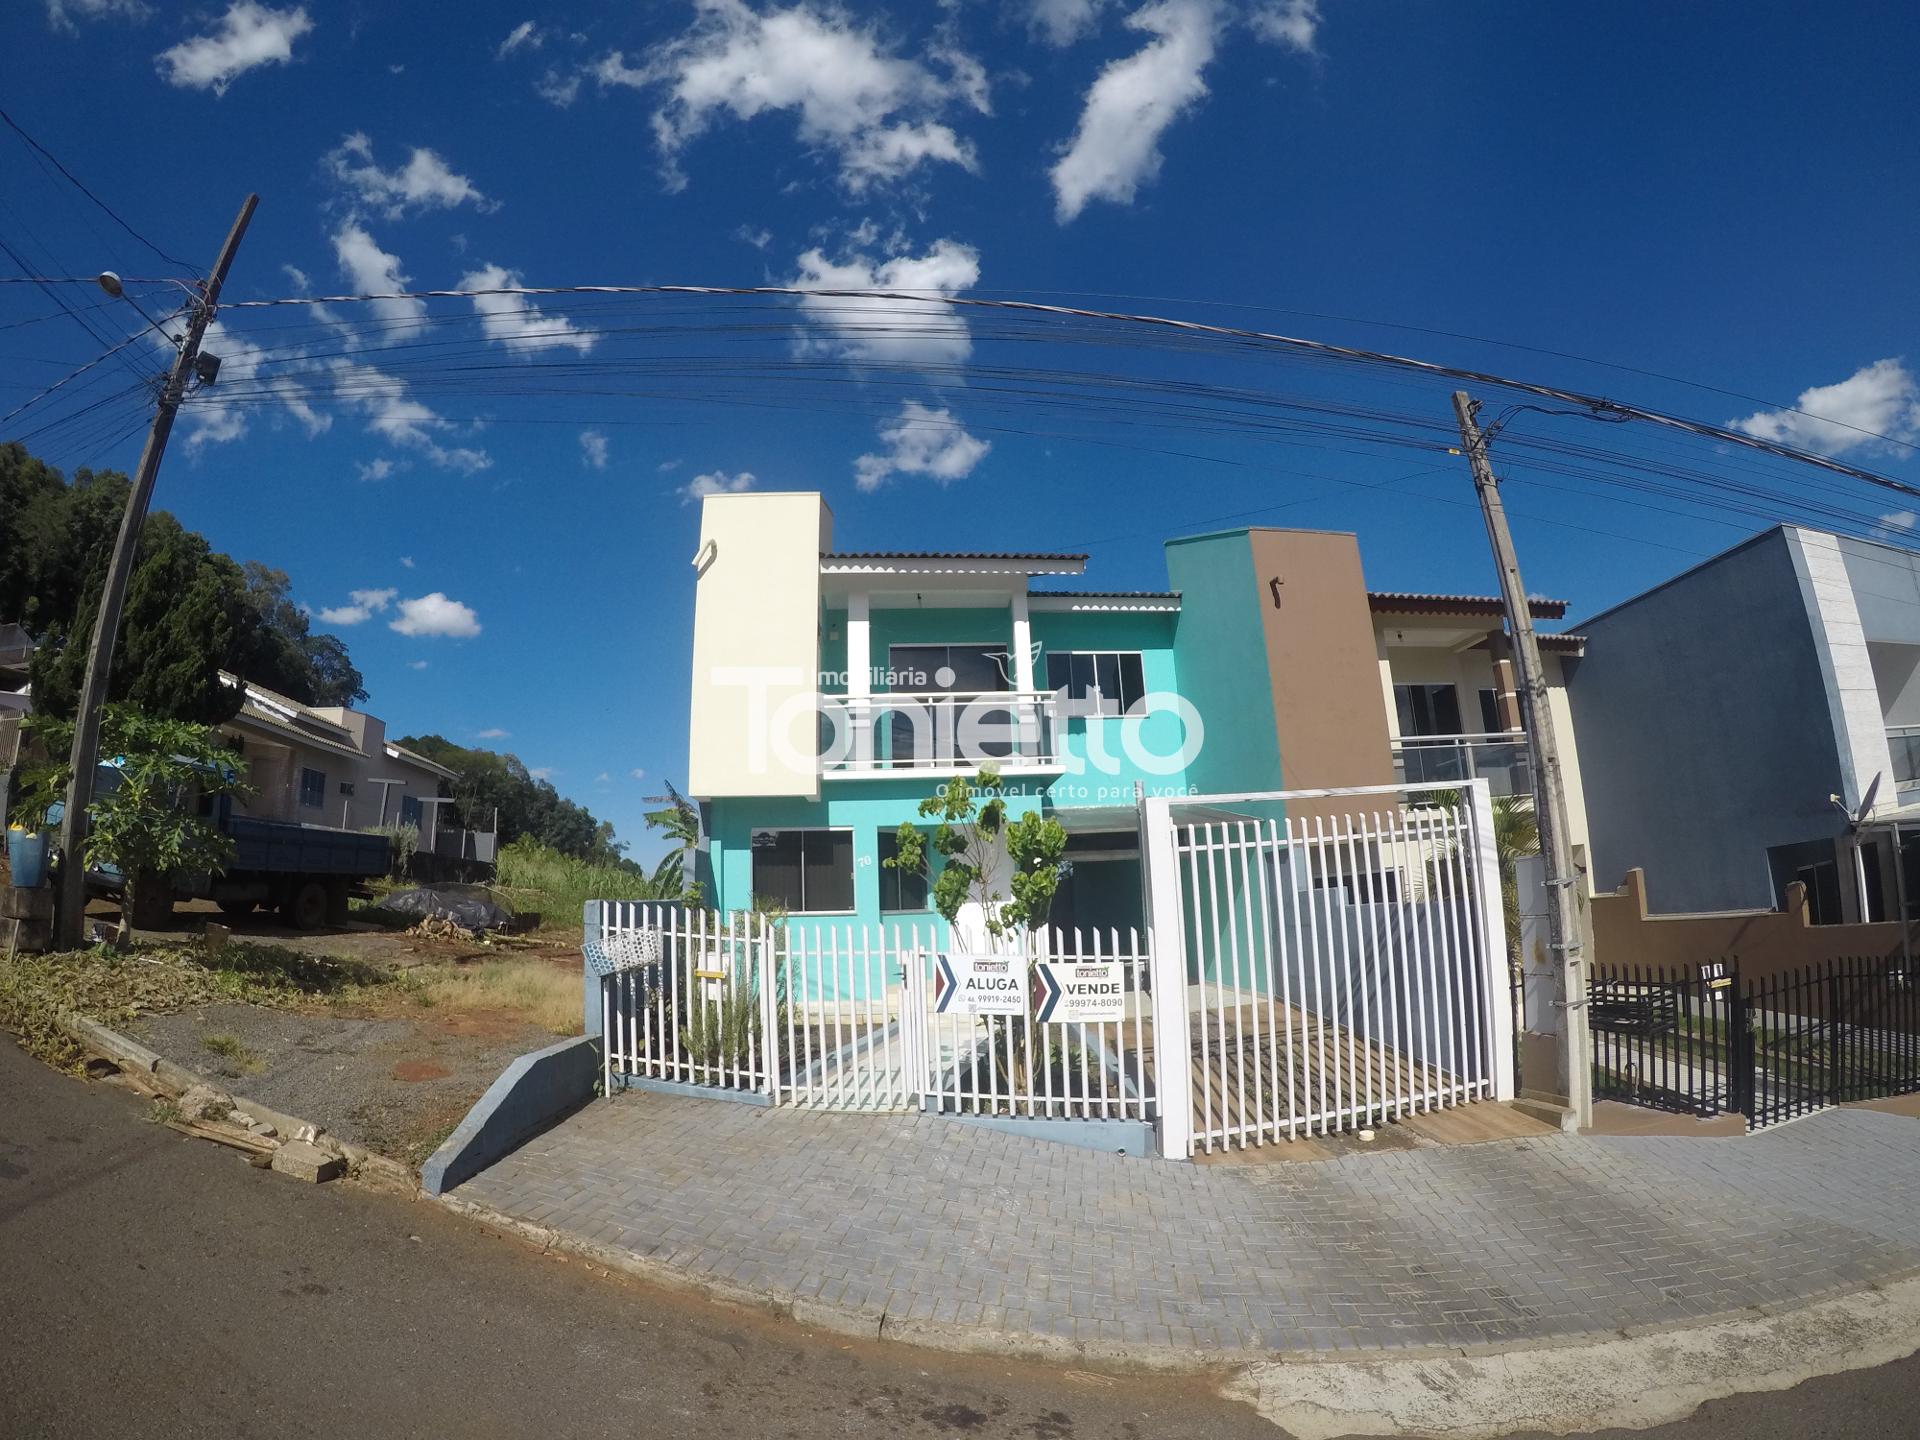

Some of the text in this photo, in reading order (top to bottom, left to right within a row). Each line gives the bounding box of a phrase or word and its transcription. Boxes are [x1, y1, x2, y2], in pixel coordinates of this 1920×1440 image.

[857, 855, 872, 867] 70
[966, 978, 1019, 990] ALUGA
[1066, 983, 1120, 995] VENDE
[978, 994, 1021, 1004] 99919-2450
[1069, 999, 1123, 1008] 99974-8090
